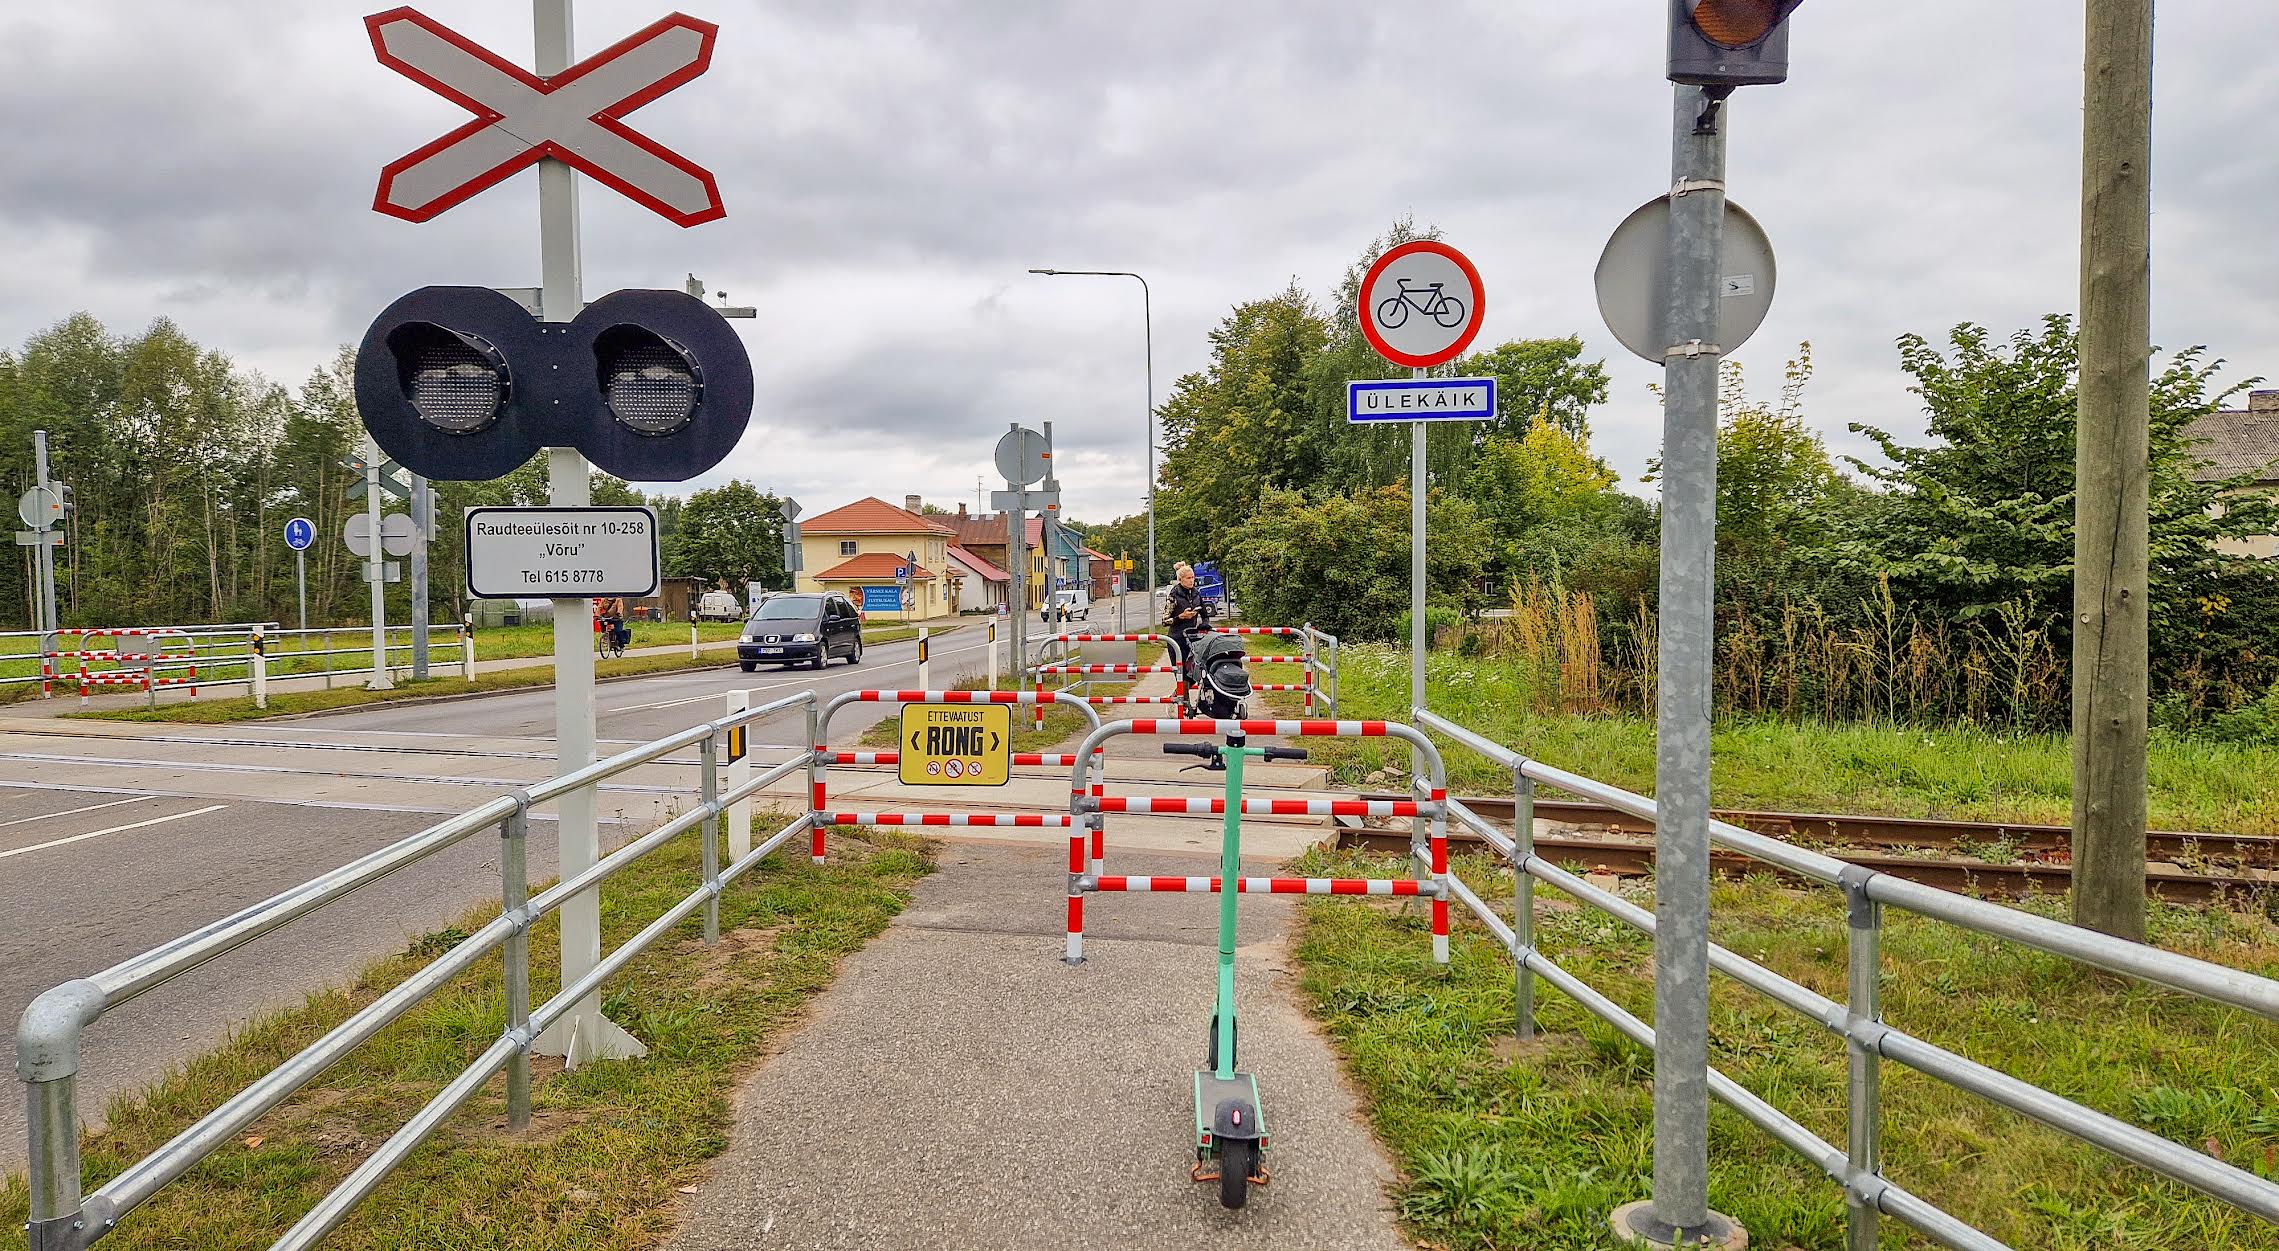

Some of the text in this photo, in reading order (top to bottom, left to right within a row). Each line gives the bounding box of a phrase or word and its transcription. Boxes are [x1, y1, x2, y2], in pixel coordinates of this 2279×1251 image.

[1367, 391, 1475, 408] ÜLEKÄIK
[477, 521, 644, 536] Raudteeülesõit nr 10-258
[521, 570, 604, 583] Tel 615 8778
[927, 710, 985, 722] ETTEVAATUST
[927, 726, 983, 756] RONG
